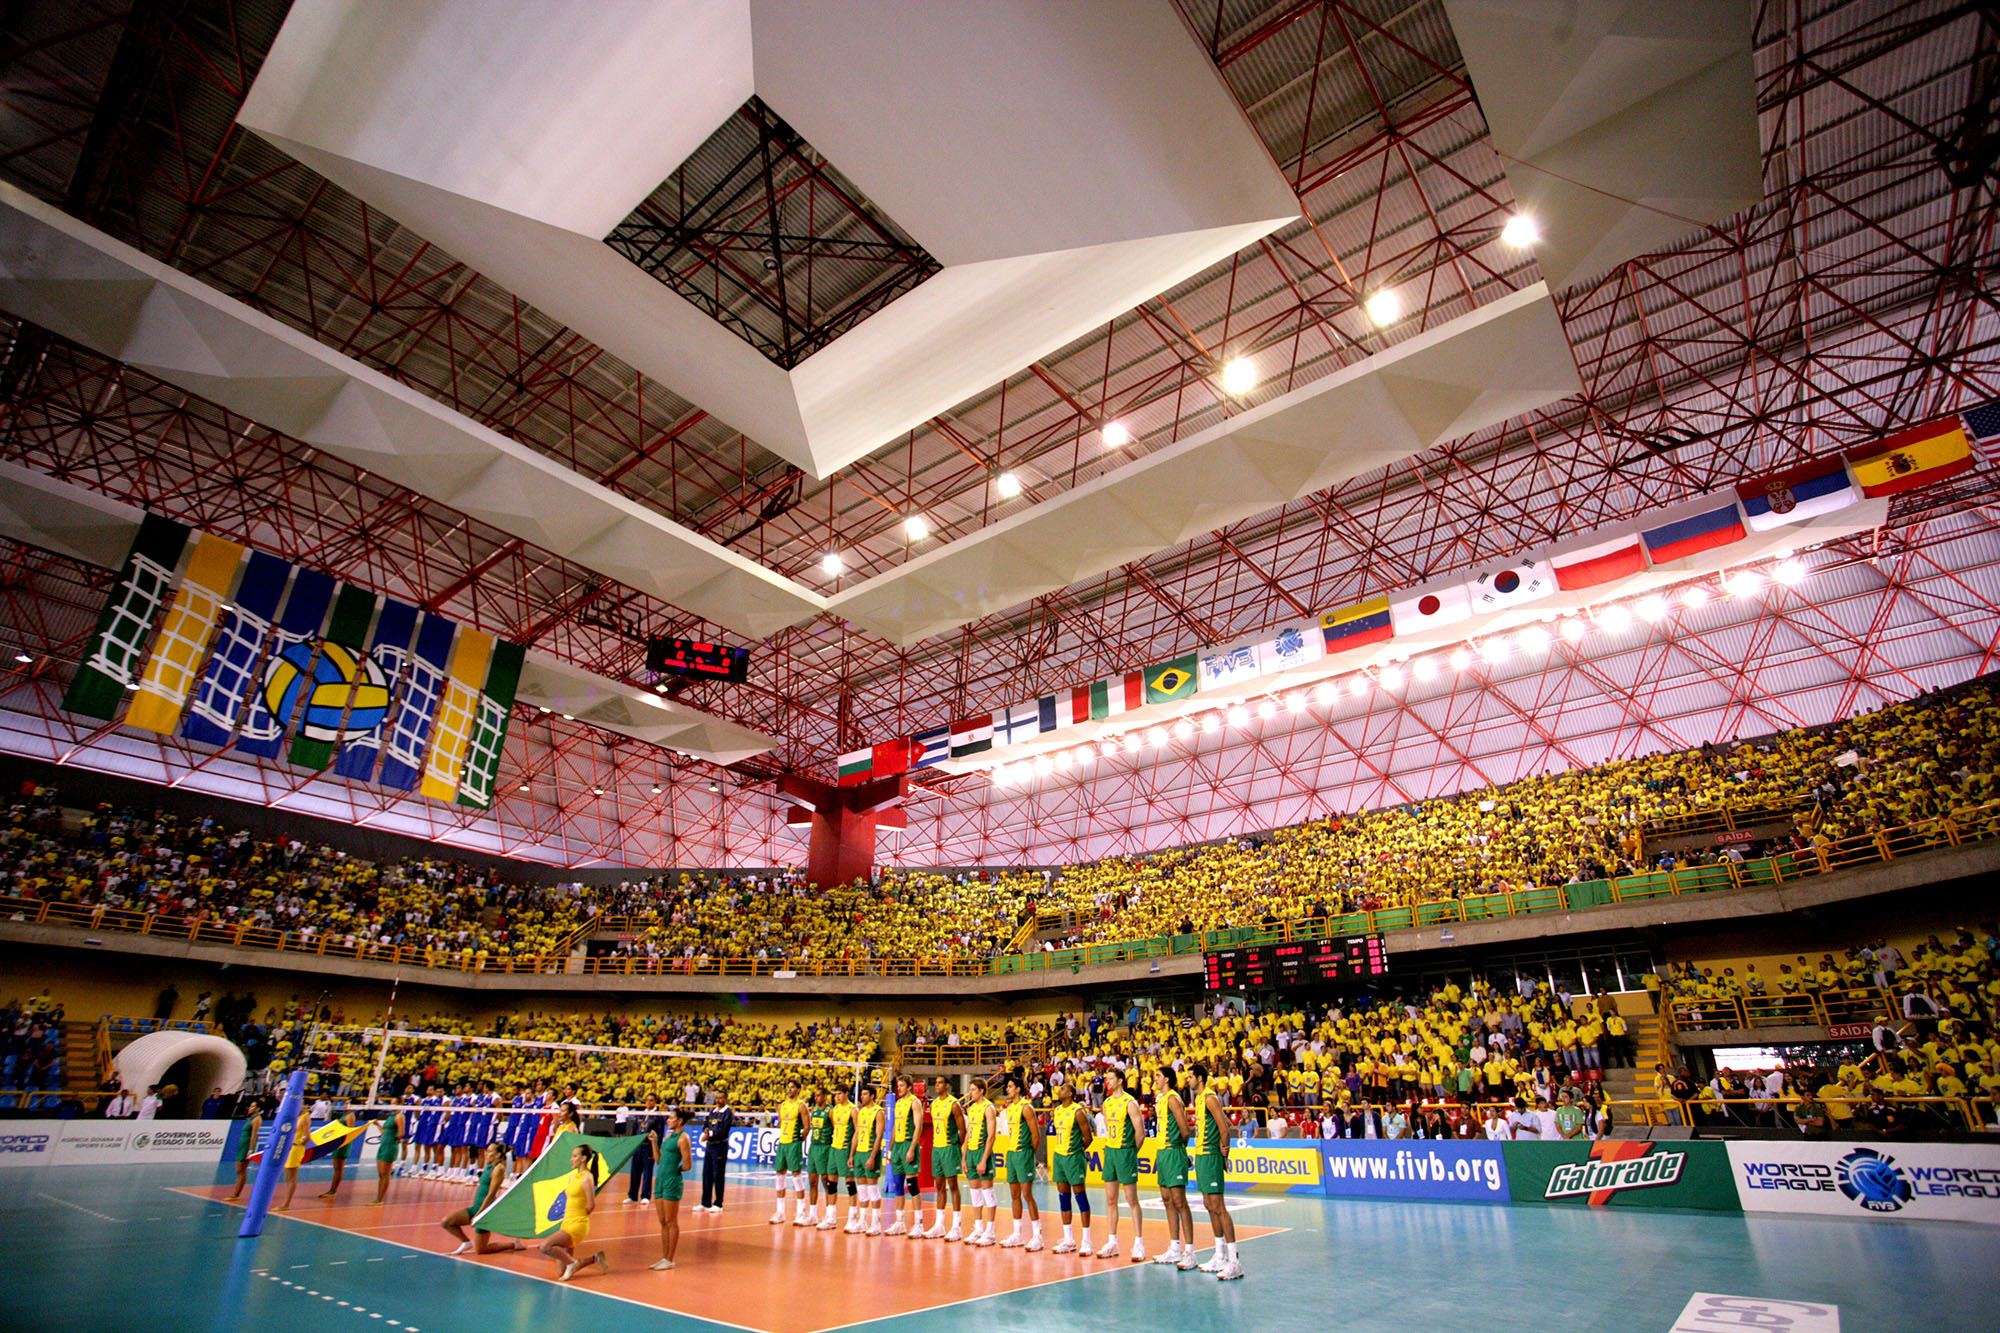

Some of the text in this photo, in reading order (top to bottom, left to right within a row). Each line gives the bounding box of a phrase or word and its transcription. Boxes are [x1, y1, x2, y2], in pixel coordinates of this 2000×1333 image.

[1204, 647, 1254, 676] FIVB
[1717, 831, 1752, 842] SAÍDA
[1830, 1025, 1872, 1037] SAÍDA
[155, 1131, 196, 1139] GOVERNO
[1109, 1125, 1116, 1139] 13
[199, 1137, 224, 1145] GOIÁS
[1235, 1159, 1255, 1173] DO
[1257, 1157, 1311, 1175] BRASIL
[1329, 1151, 1500, 1191] www.fivb.org
[1743, 1162, 1832, 1177] WORLD
[1549, 1155, 1682, 1194] Gatorade
[1746, 1175, 1836, 1192] LEAGUE
[1912, 1181, 2000, 1199] LEAGU
[1868, 1201, 1896, 1210] FIVB
